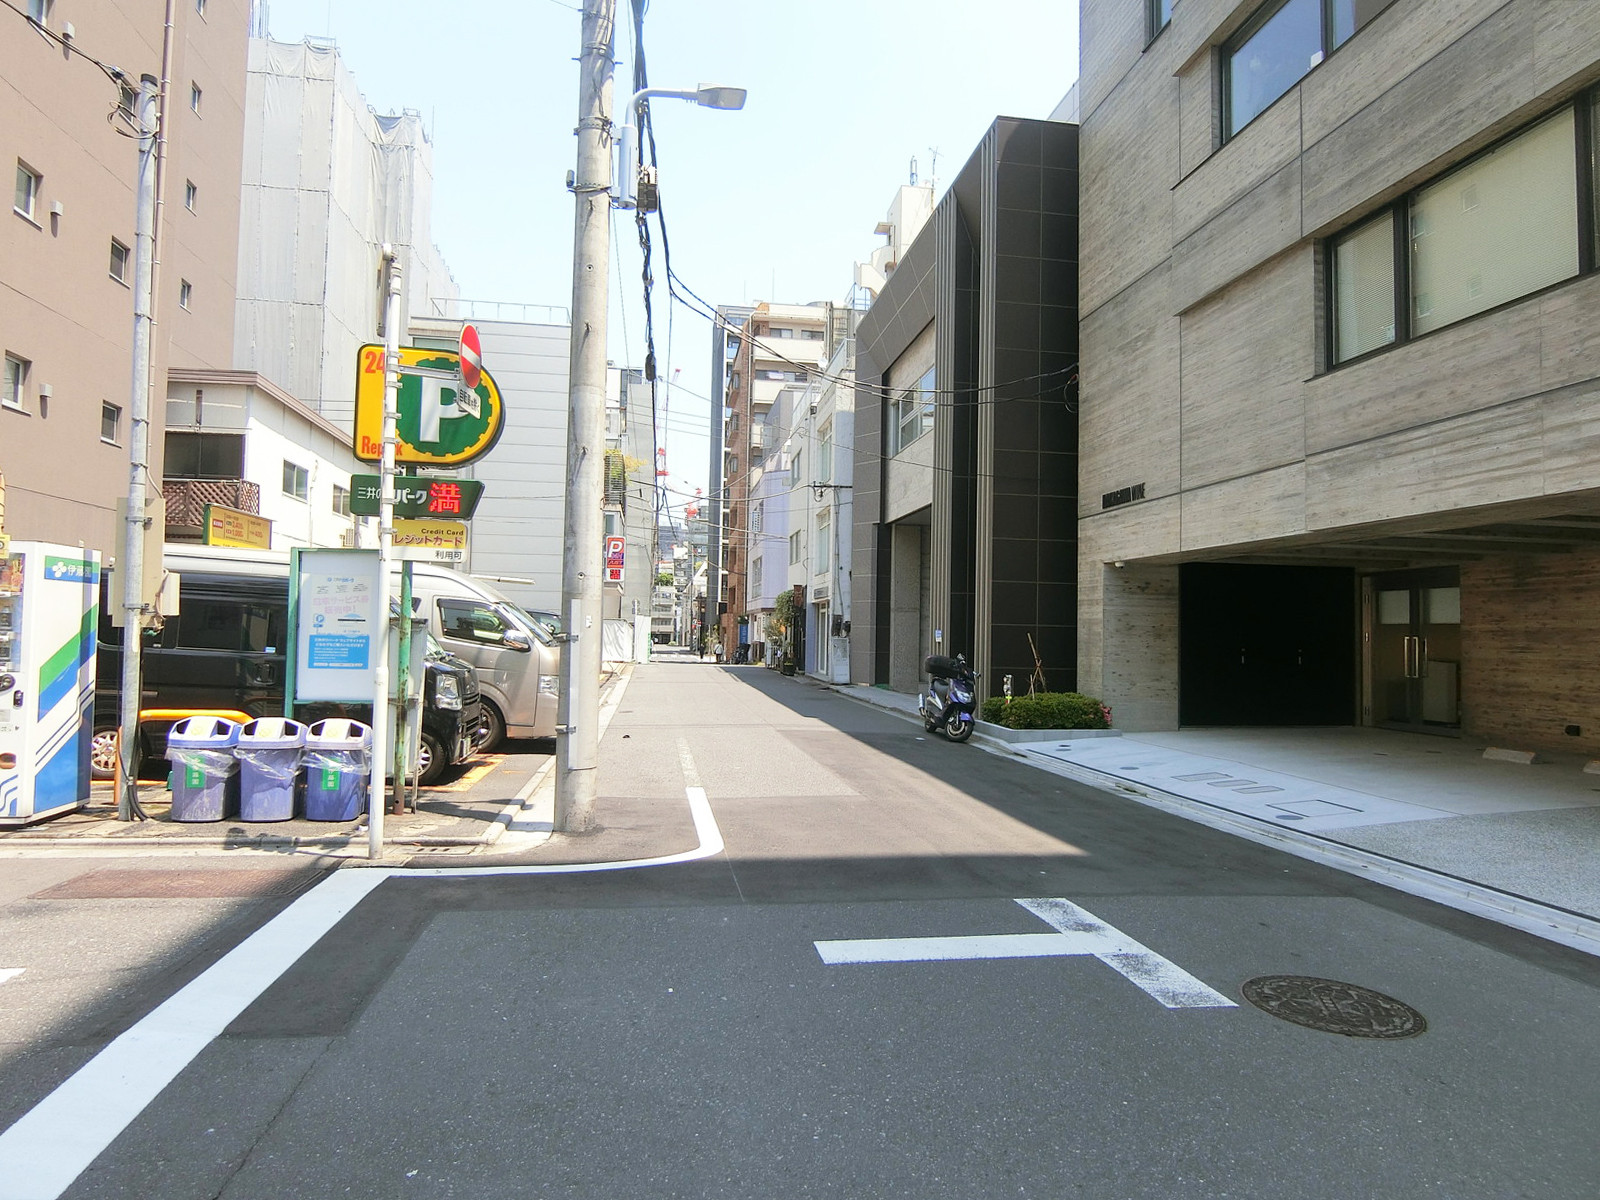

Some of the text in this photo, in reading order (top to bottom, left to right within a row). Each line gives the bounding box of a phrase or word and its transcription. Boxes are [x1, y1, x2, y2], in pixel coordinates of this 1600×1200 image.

[361, 435, 403, 457] Repk
[428, 482, 462, 513] 満
[393, 534, 463, 547] レジットカード
[435, 550, 462, 560] 利用可
